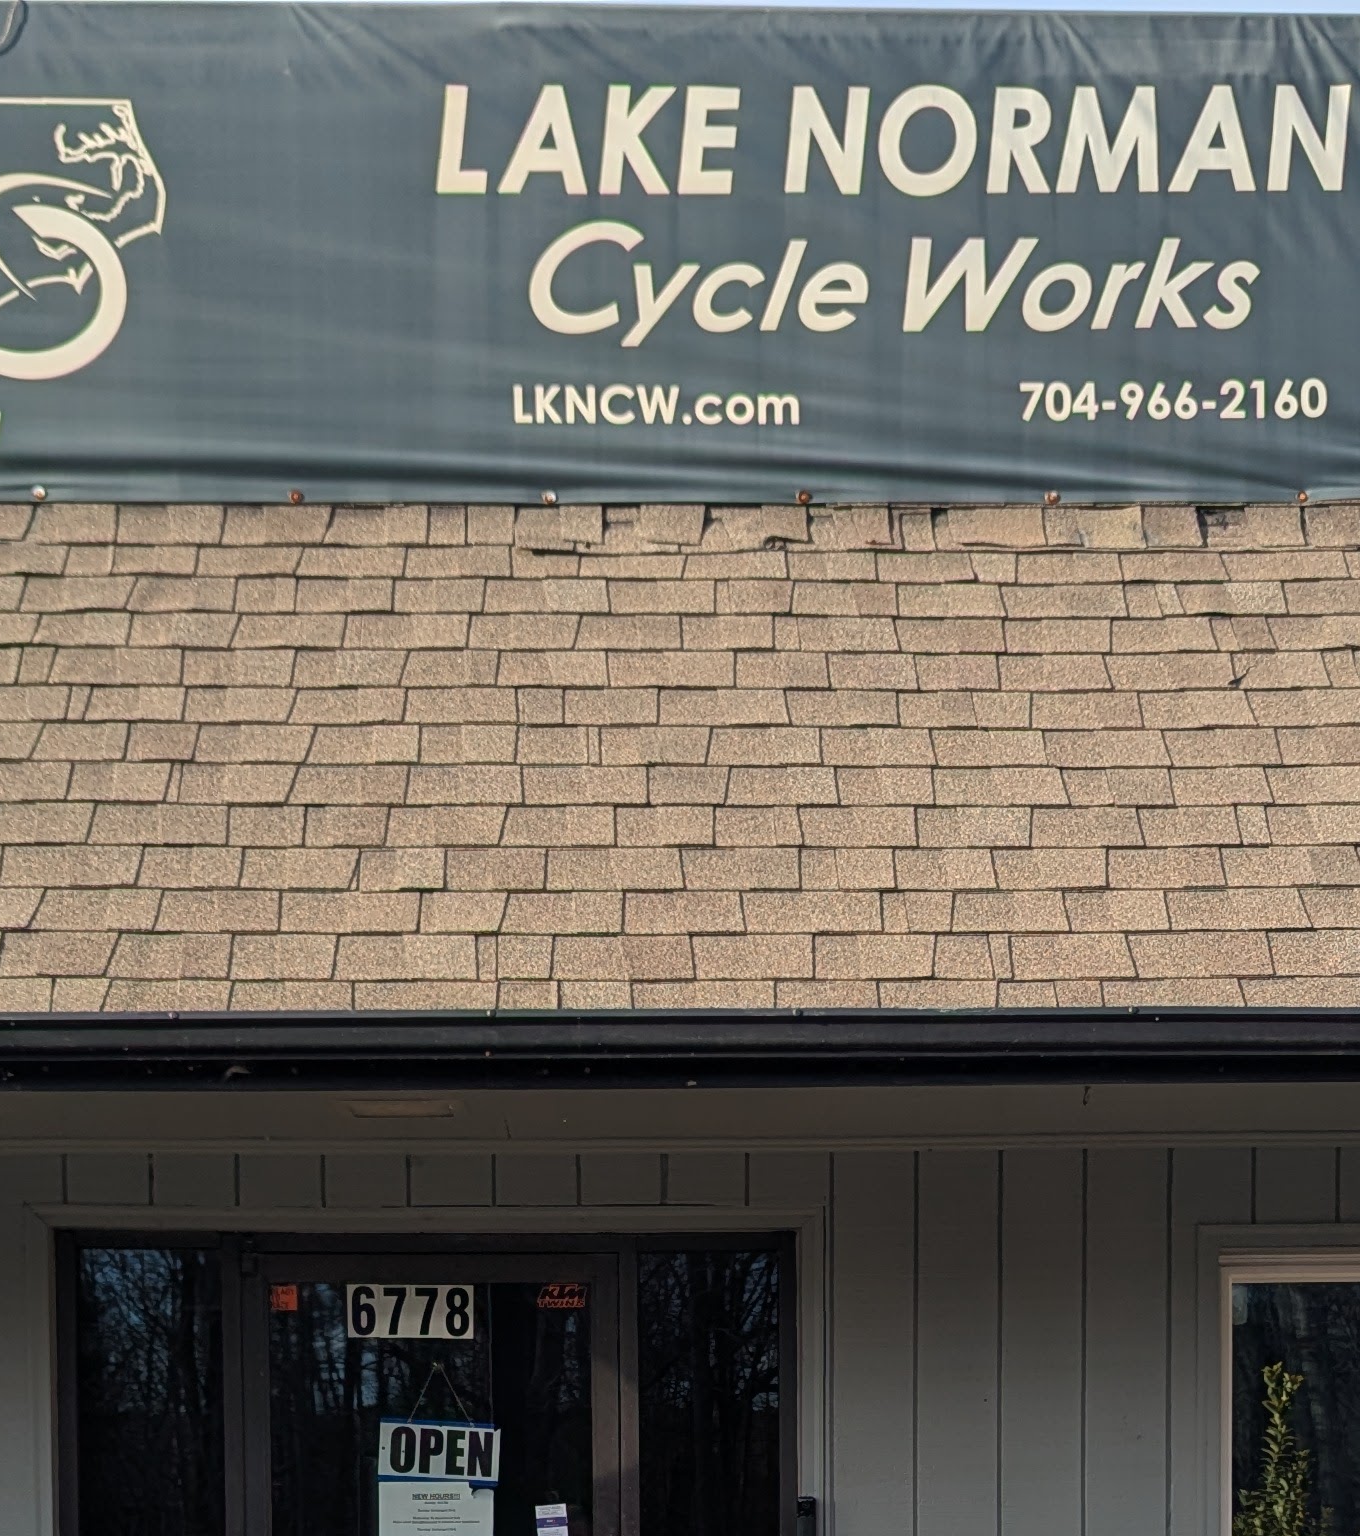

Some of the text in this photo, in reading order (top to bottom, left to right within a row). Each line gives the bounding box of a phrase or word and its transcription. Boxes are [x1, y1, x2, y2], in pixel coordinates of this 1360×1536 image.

[435, 84, 1352, 197] LAKE NORMAN
[529, 220, 1261, 347] Cycle Works
[512, 384, 800, 425] LKNCW.com
[1019, 378, 1328, 422] 704-966-2160
[351, 1285, 470, 1337] 6778
[540, 1284, 586, 1300] KTM
[390, 1425, 494, 1478] OPEN
